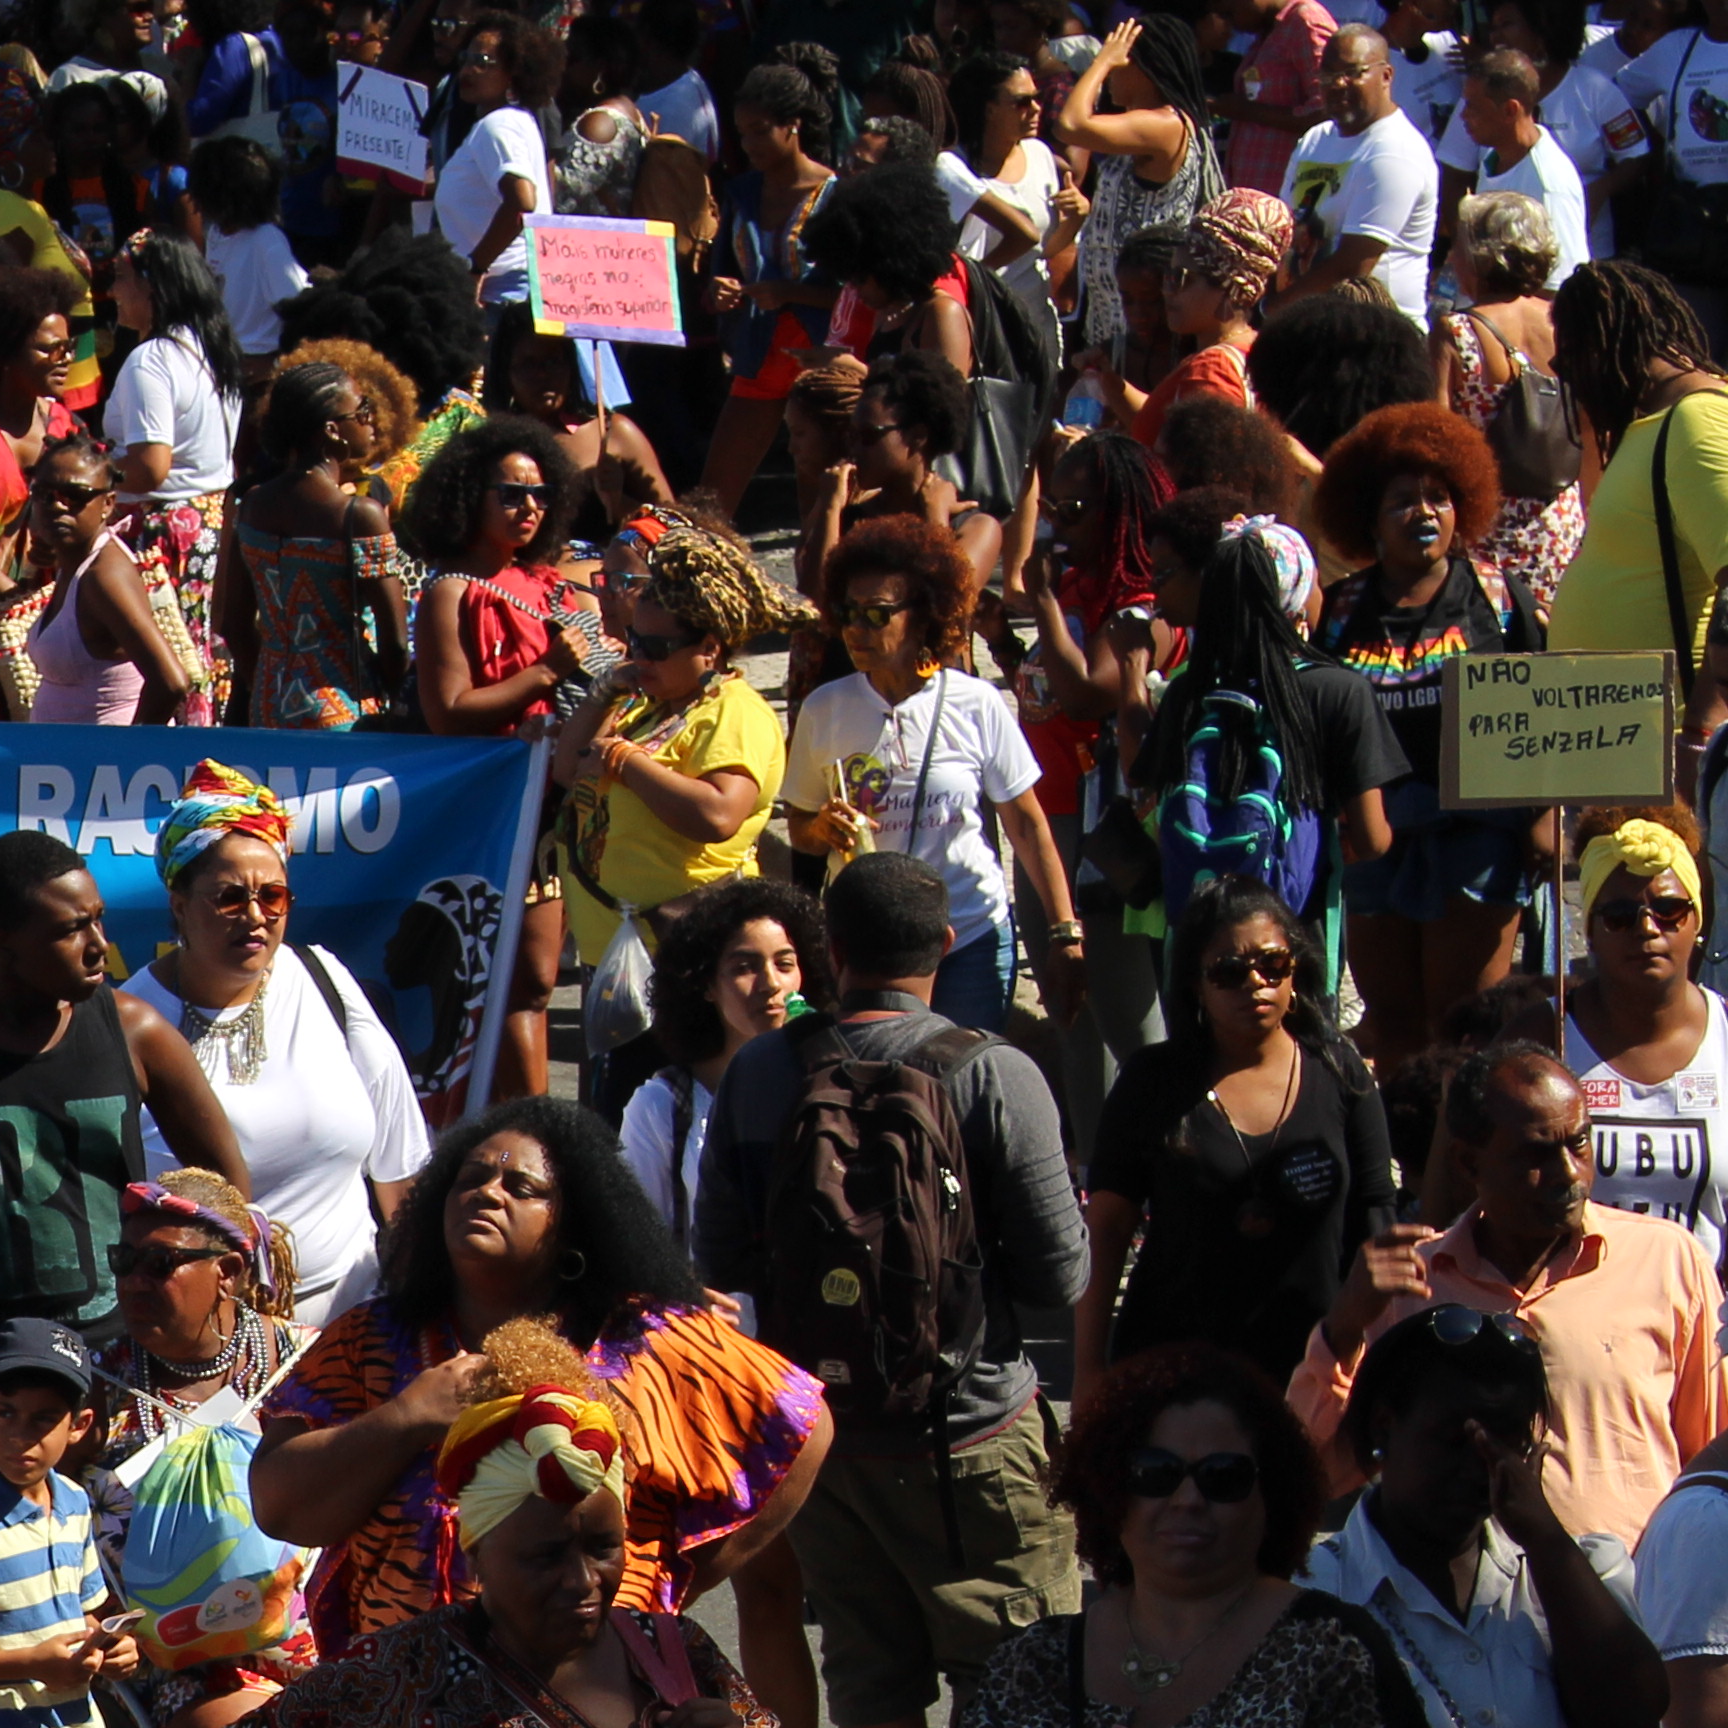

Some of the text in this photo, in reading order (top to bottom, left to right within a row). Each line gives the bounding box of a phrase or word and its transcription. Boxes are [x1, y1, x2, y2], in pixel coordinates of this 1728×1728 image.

[345, 130, 411, 169] PRESENTE!
[1467, 661, 1531, 689] NÃO
[1532, 682, 1665, 710] VOLTAREMOS
[1468, 712, 1530, 737] PARA
[1504, 723, 1642, 761] SENZALA
